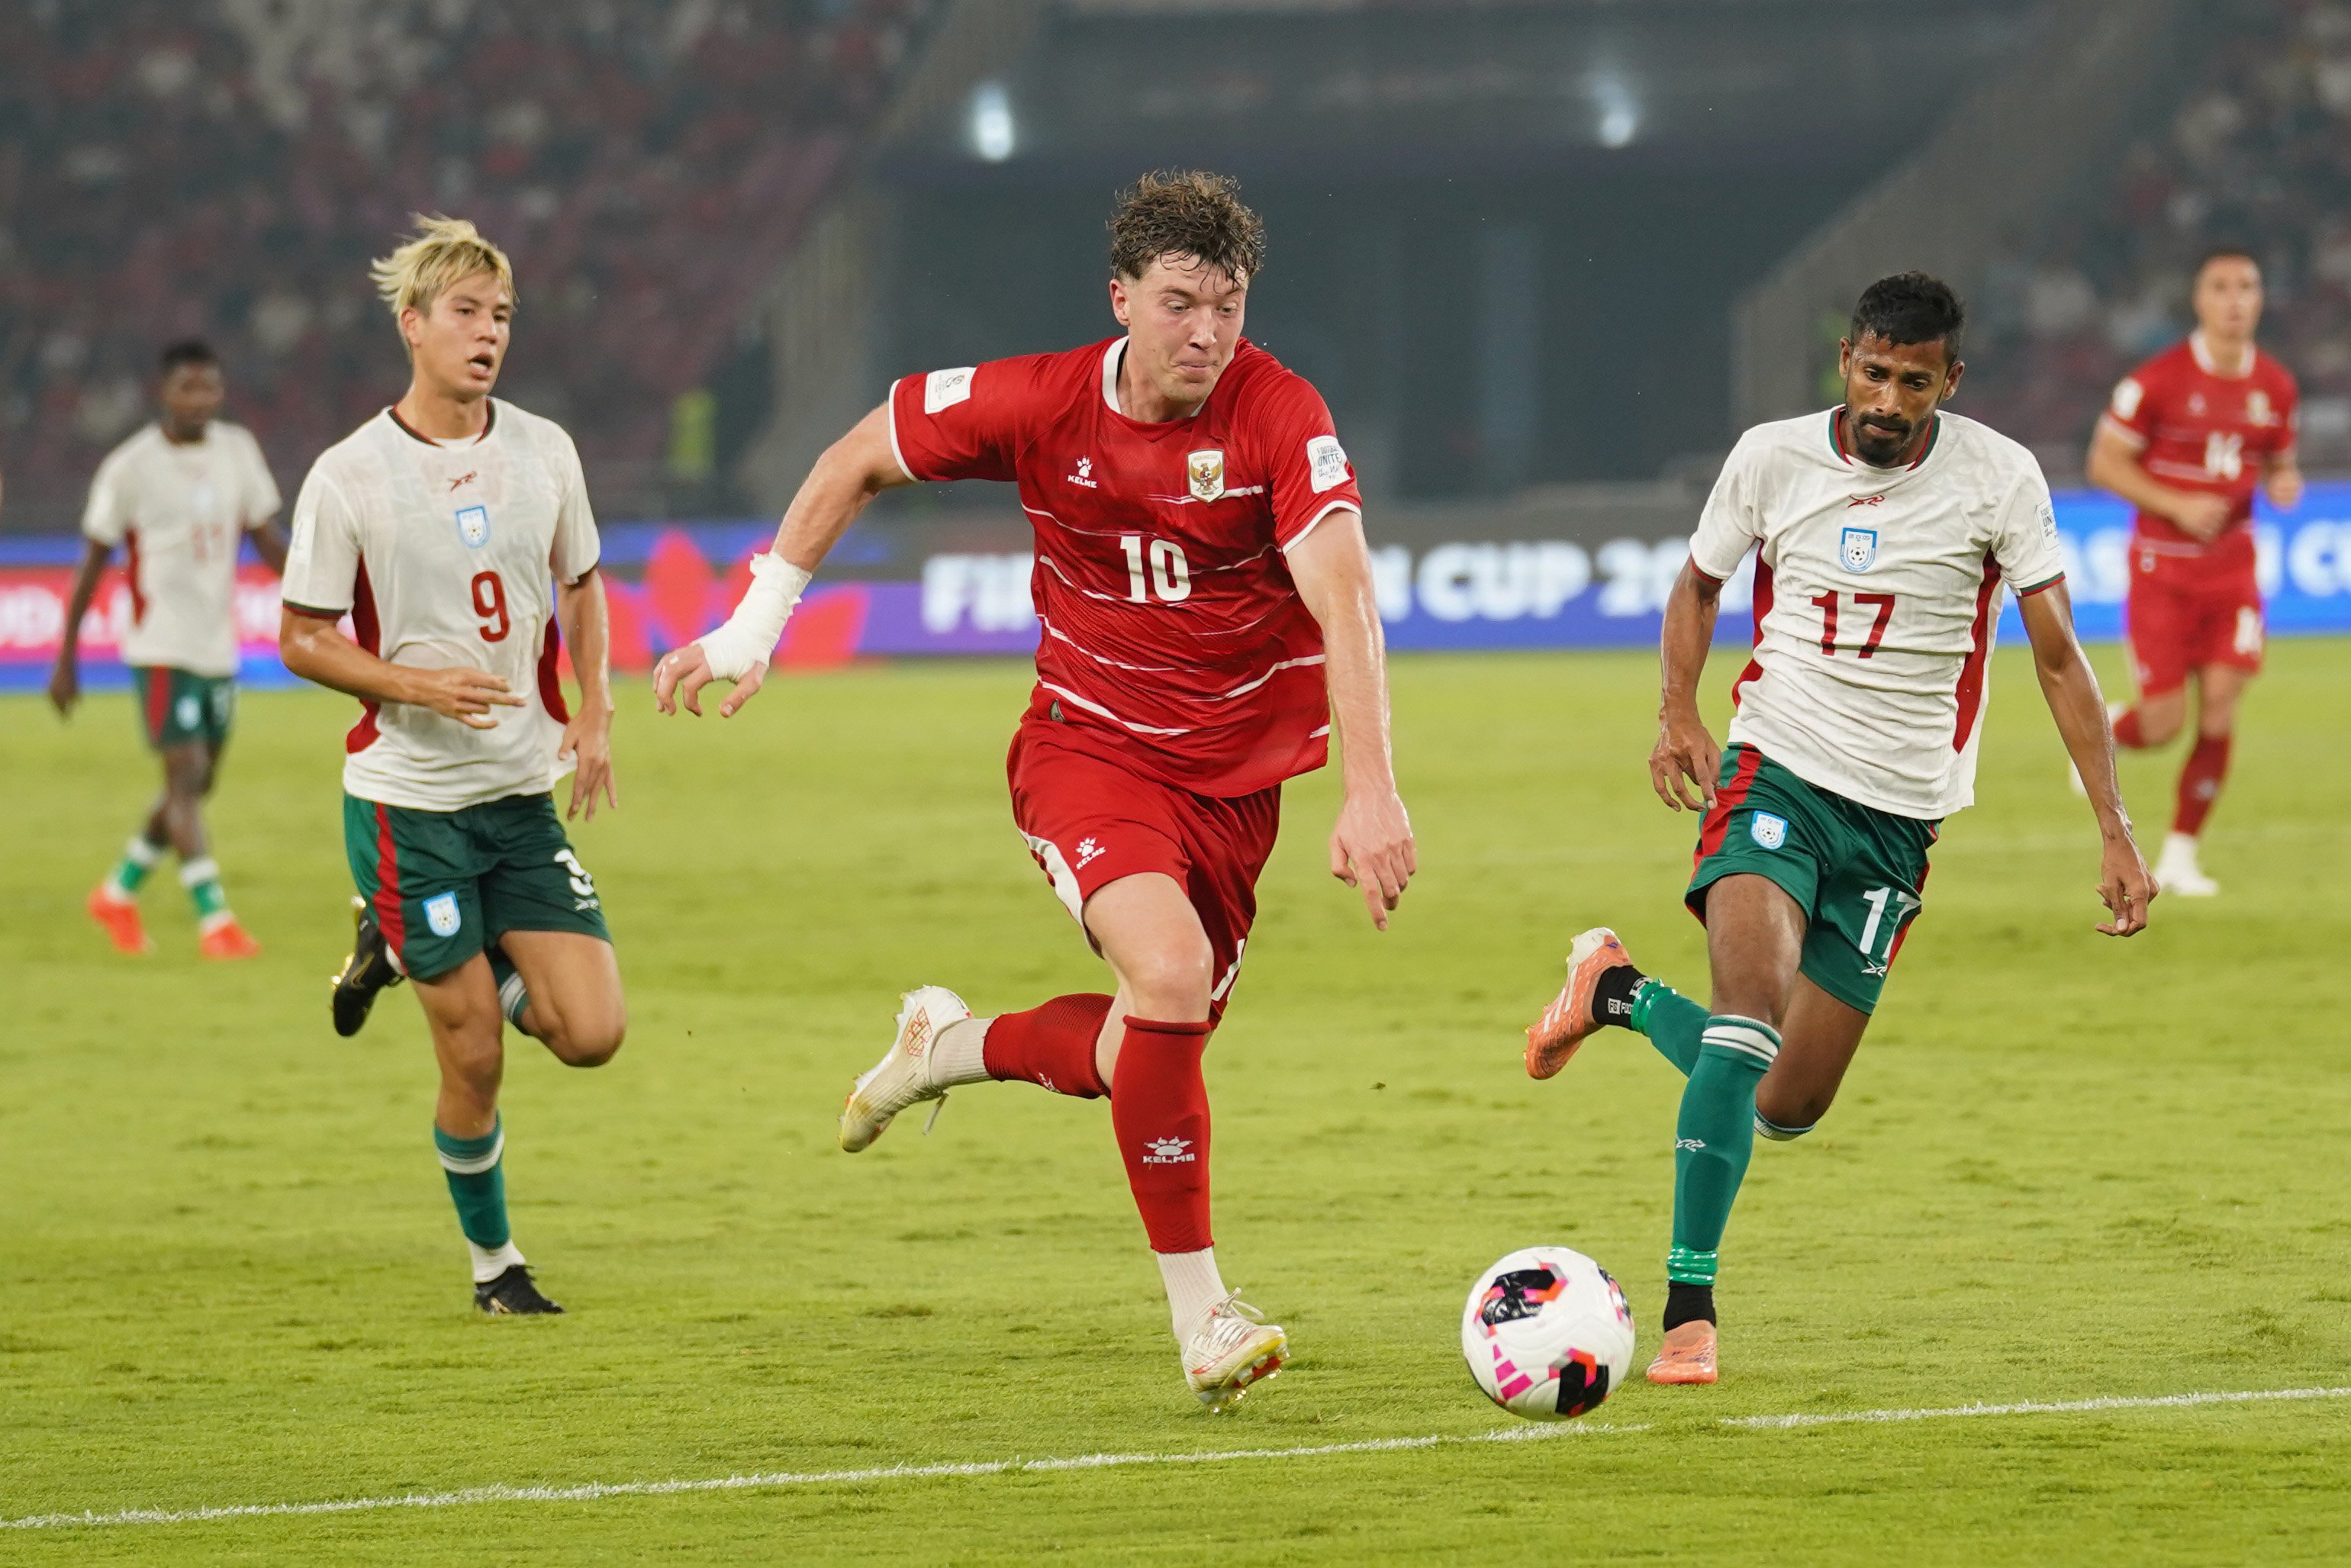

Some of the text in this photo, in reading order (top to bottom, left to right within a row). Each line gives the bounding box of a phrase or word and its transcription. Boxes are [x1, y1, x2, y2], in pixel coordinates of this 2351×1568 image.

[1068, 475, 1097, 488] KELME
[1120, 536, 1191, 602] 10
[1417, 540, 1591, 623] CUP
[472, 571, 510, 642] 9
[1812, 590, 1896, 659] 17
[1076, 846, 1106, 870] KELME
[1859, 887, 1922, 959] 17
[1609, 1000, 1618, 1012] FS
